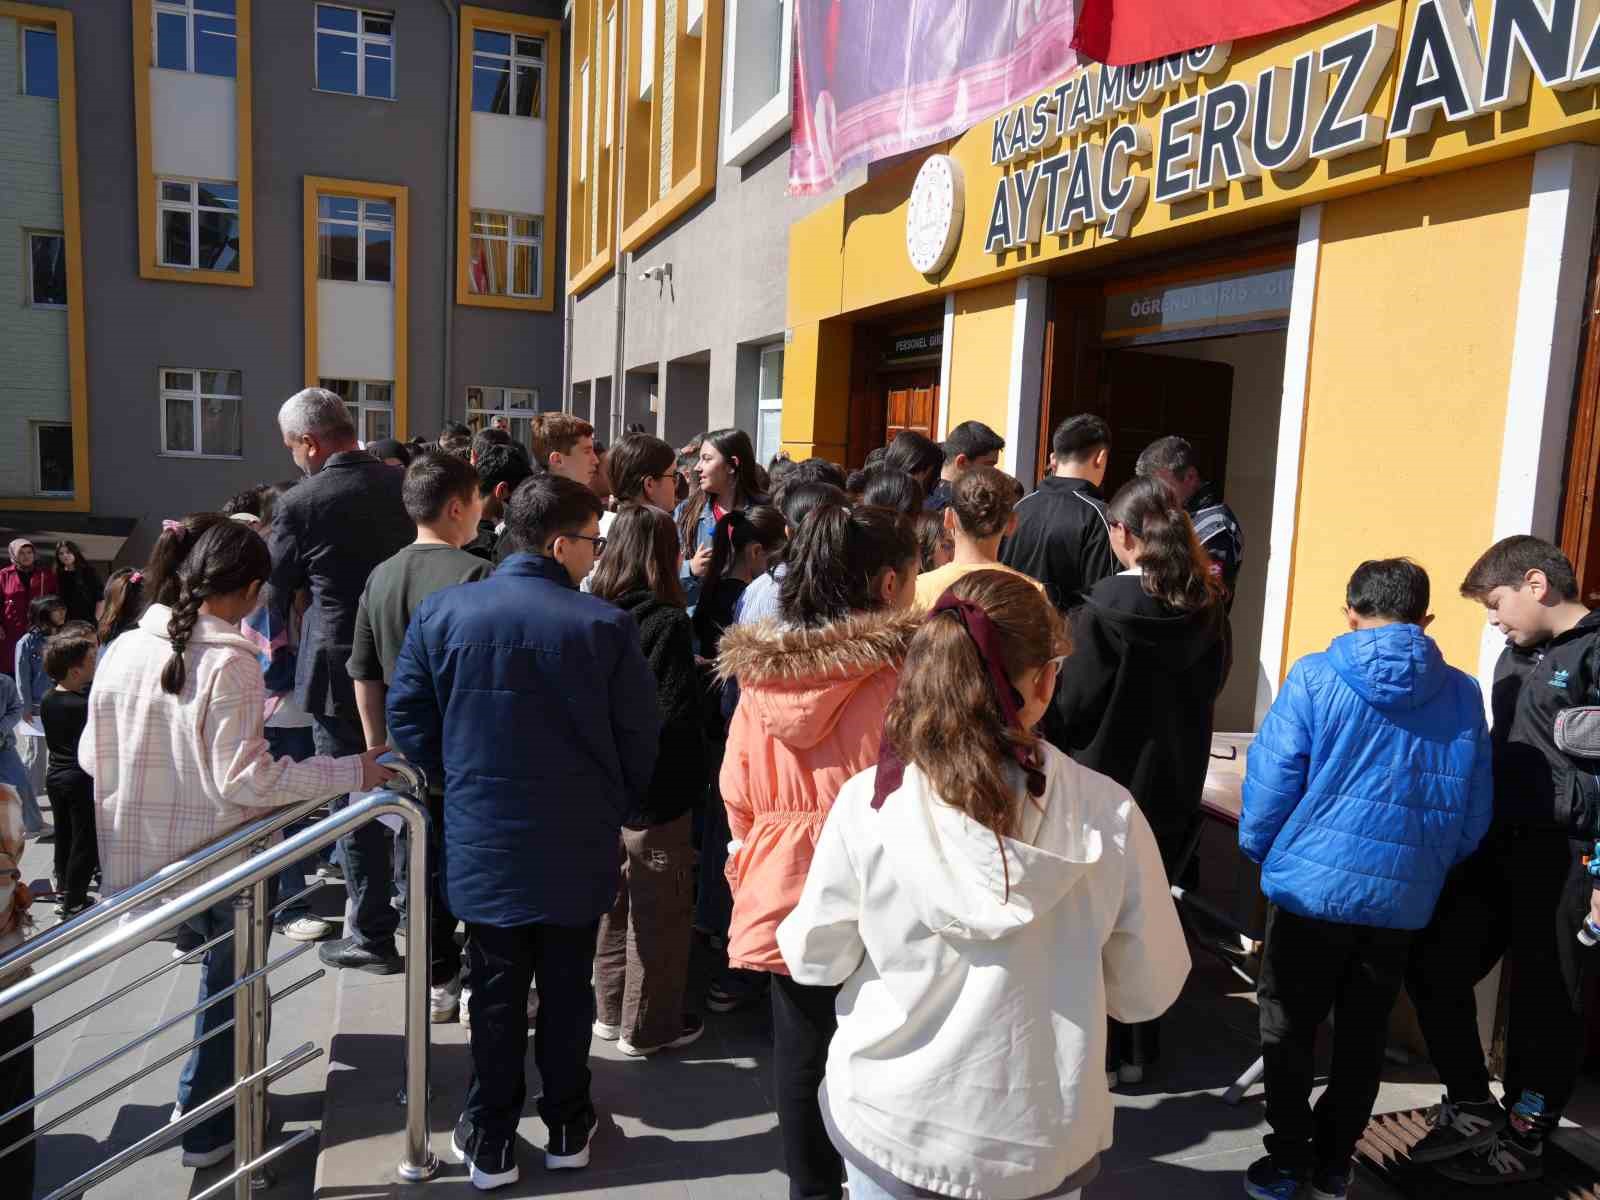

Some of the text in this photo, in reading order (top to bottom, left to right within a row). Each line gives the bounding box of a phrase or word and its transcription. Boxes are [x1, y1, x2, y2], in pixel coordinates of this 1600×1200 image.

[983, 124, 1137, 253] AYTAÇ
[1155, 23, 1378, 203] ERUZ
[1386, 0, 1600, 139] AN
